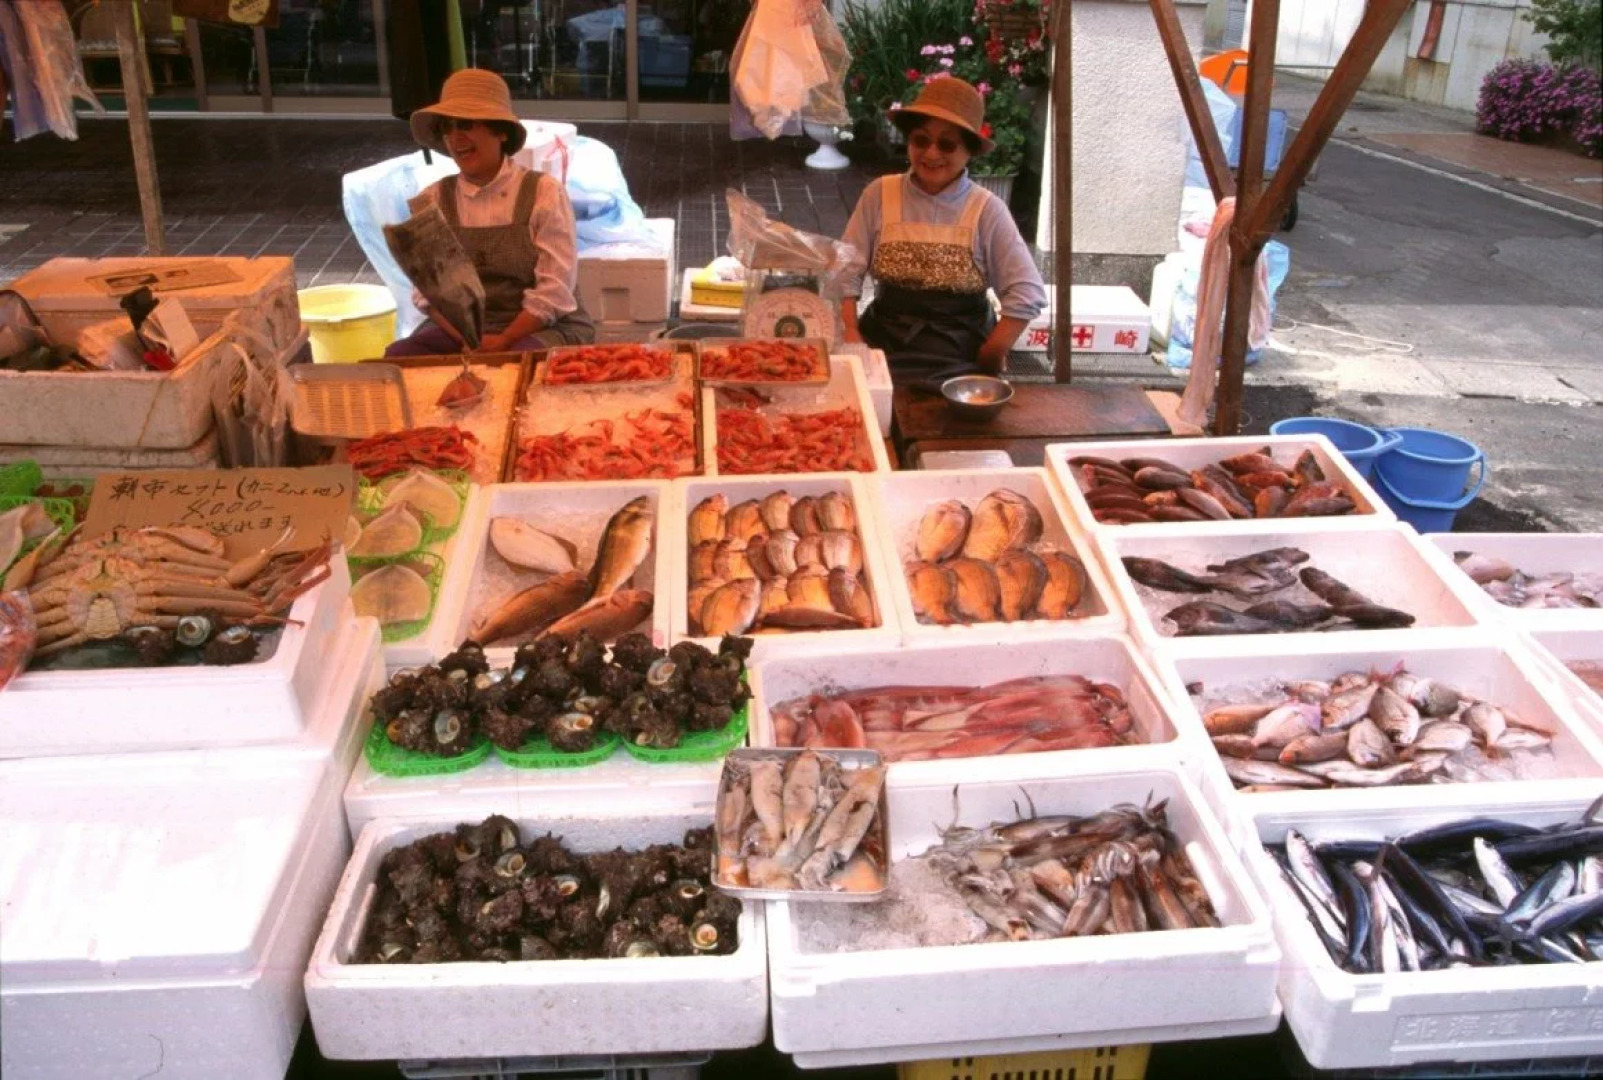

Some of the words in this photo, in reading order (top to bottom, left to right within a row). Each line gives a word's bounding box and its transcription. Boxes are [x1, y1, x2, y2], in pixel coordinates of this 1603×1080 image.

[1114, 330, 1138, 348] 崎
[1406, 1012, 1523, 1040] 北海道
